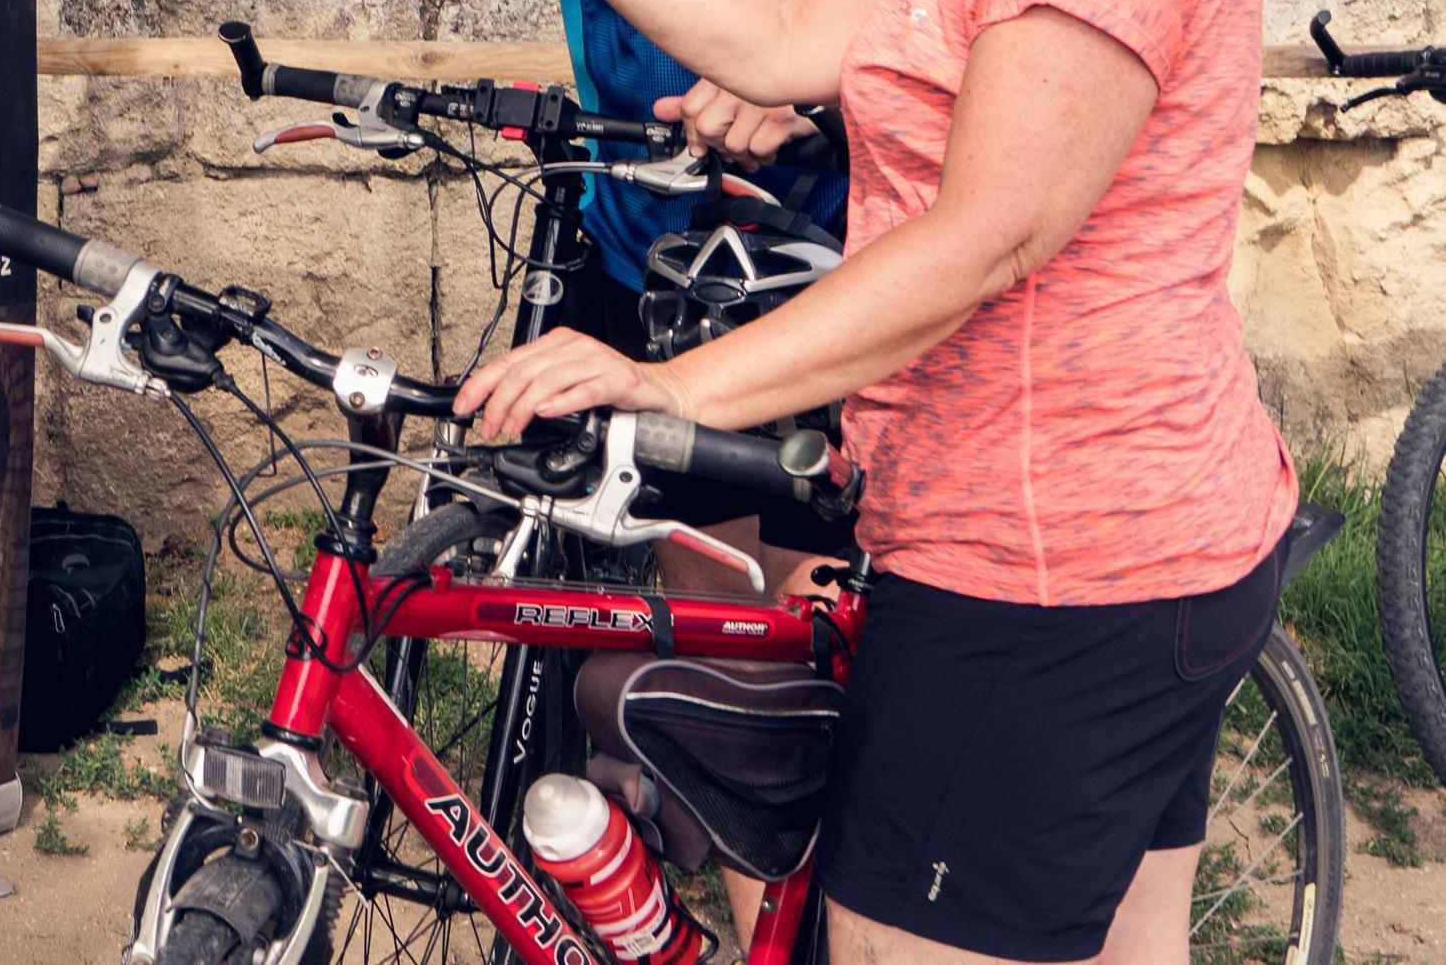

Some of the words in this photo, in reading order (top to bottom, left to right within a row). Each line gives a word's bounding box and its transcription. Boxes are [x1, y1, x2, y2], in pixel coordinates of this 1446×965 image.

[514, 602, 653, 633] REFLEX
[513, 660, 543, 764] VOGUE
[425, 794, 592, 965] AUTHO
